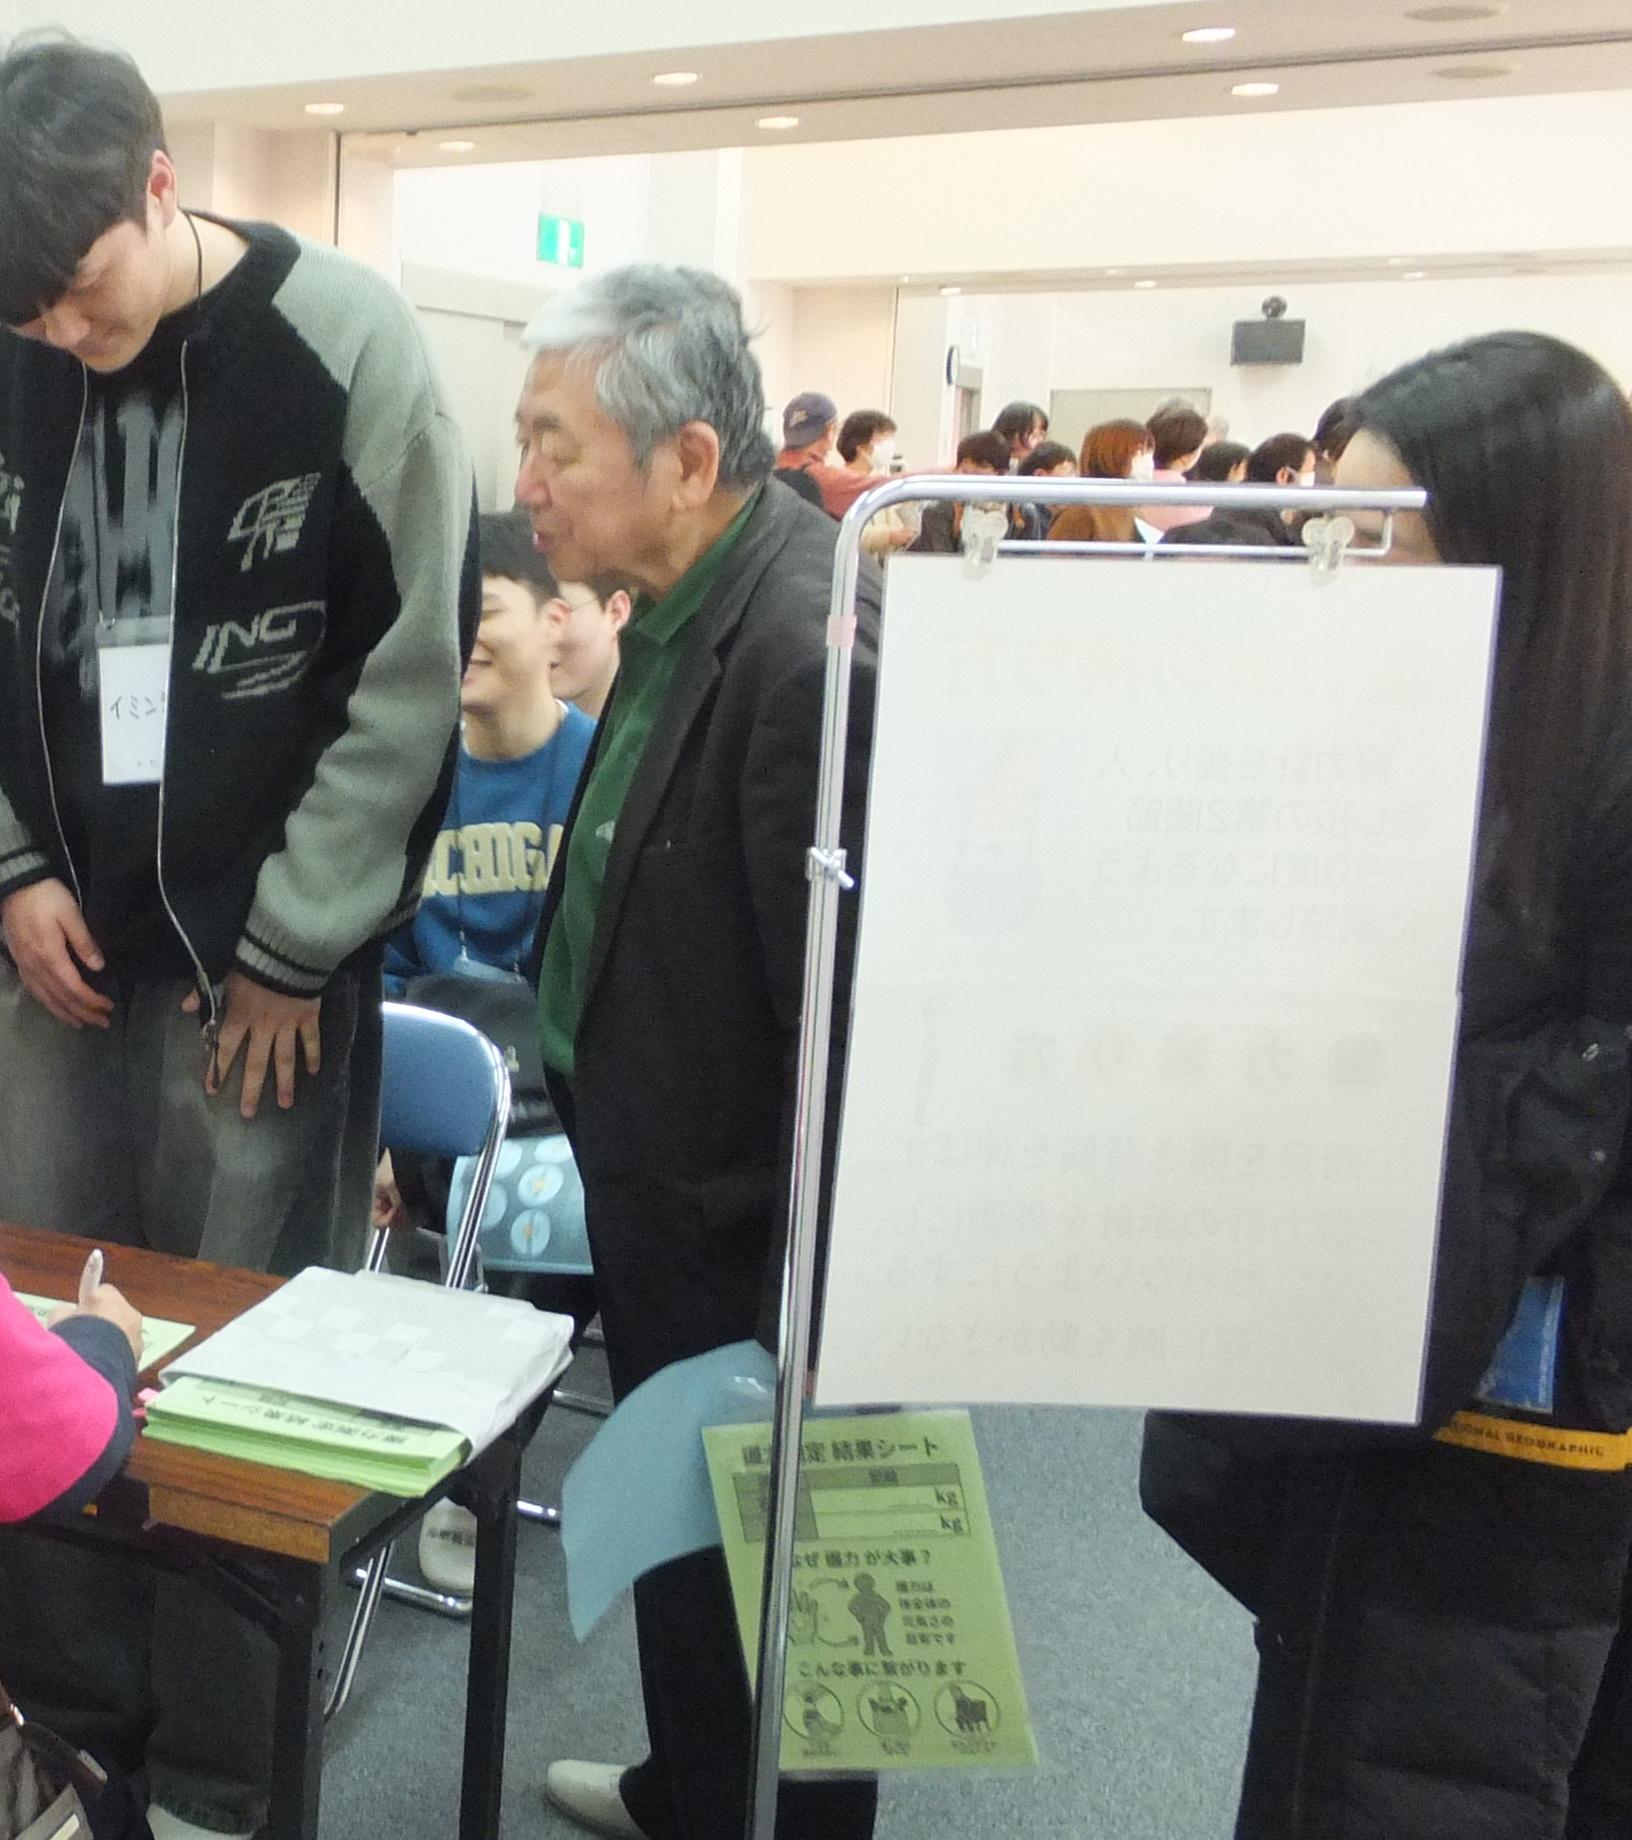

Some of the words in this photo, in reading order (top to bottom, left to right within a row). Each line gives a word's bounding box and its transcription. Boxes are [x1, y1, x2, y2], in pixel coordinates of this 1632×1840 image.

[109, 691, 166, 719] イミン
[934, 1486, 959, 1508] kg
[939, 1515, 963, 1534] kg
